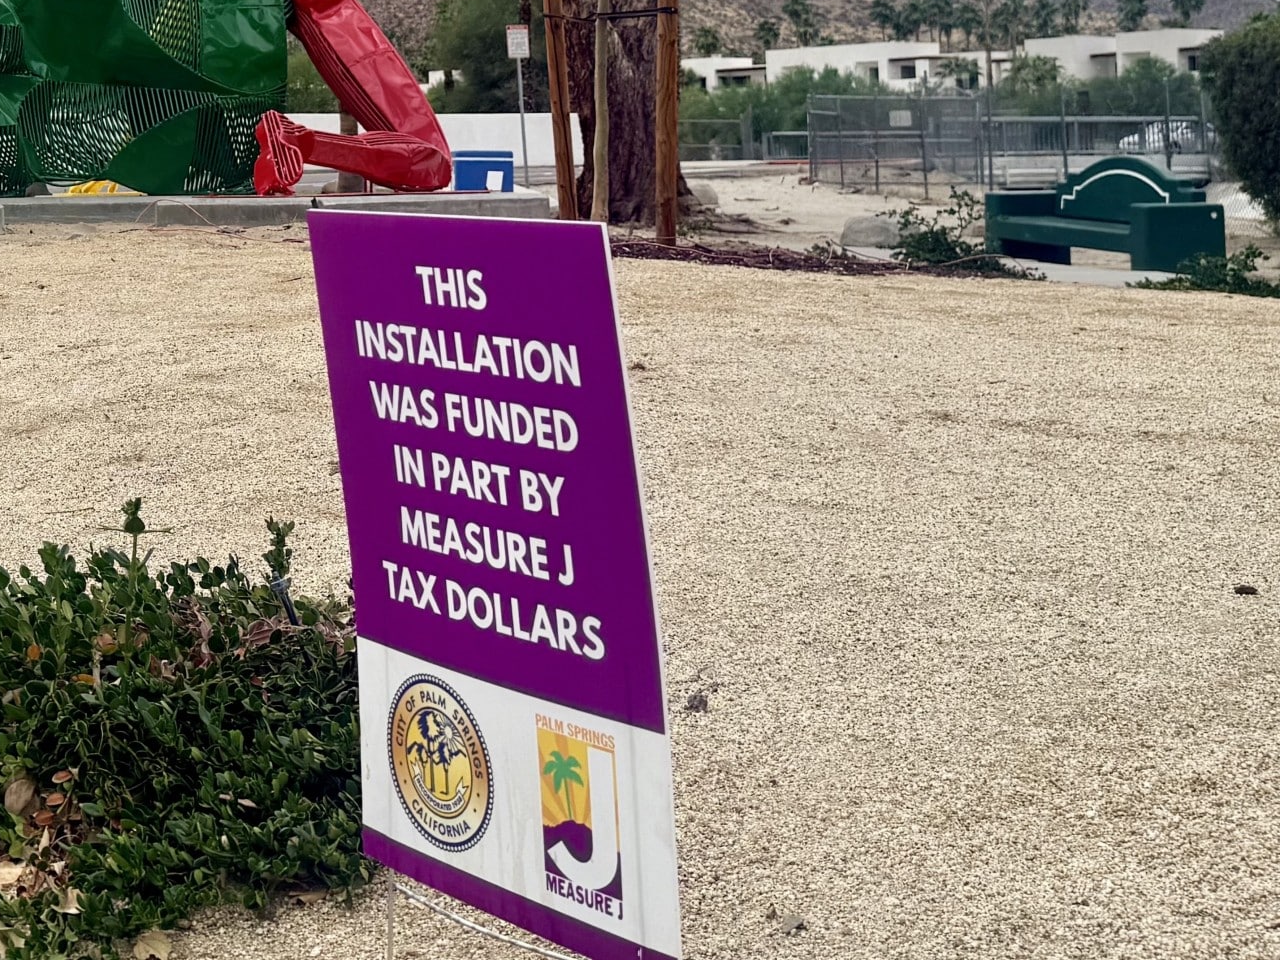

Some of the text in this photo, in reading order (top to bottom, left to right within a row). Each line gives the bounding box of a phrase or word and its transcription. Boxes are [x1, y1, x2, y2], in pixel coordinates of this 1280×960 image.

[415, 265, 488, 311] THIS
[354, 320, 582, 387] INSTALLATION
[368, 380, 579, 453] WAS FUNDED
[393, 444, 565, 517] IN PART BY
[400, 506, 574, 586] MEASURE J
[382, 560, 606, 661] TAX DOLLARS
[395, 690, 484, 780] CITY OF PALM SPRINGS
[535, 713, 616, 750] PALM SPRINGS
[412, 798, 472, 838] CALIFORNIA
[545, 873, 624, 921] MEASURE J
